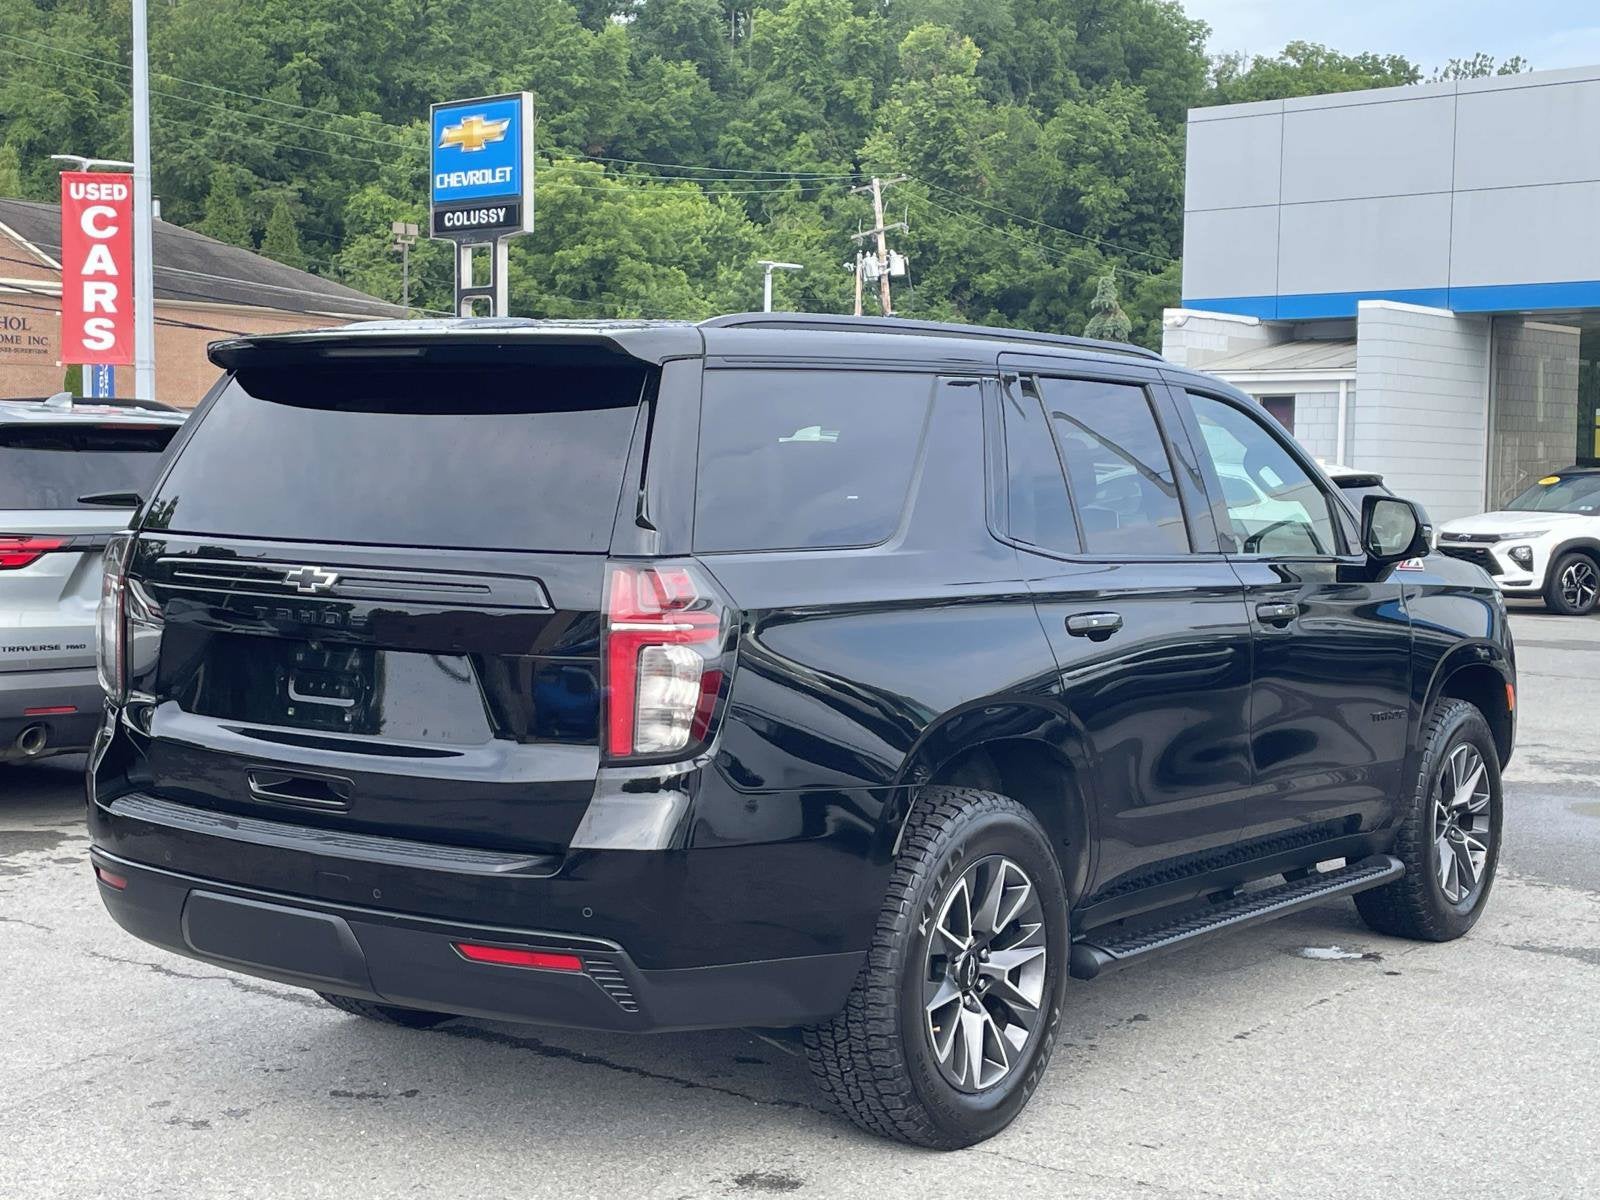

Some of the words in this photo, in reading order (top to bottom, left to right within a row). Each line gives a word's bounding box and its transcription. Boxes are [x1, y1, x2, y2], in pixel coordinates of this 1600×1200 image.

[436, 167, 513, 189] CHEVROLET
[70, 183, 128, 200] USED
[444, 207, 507, 227] COLUSSY
[81, 205, 119, 351] CARS
[2, 644, 61, 653] TRAVERSE
